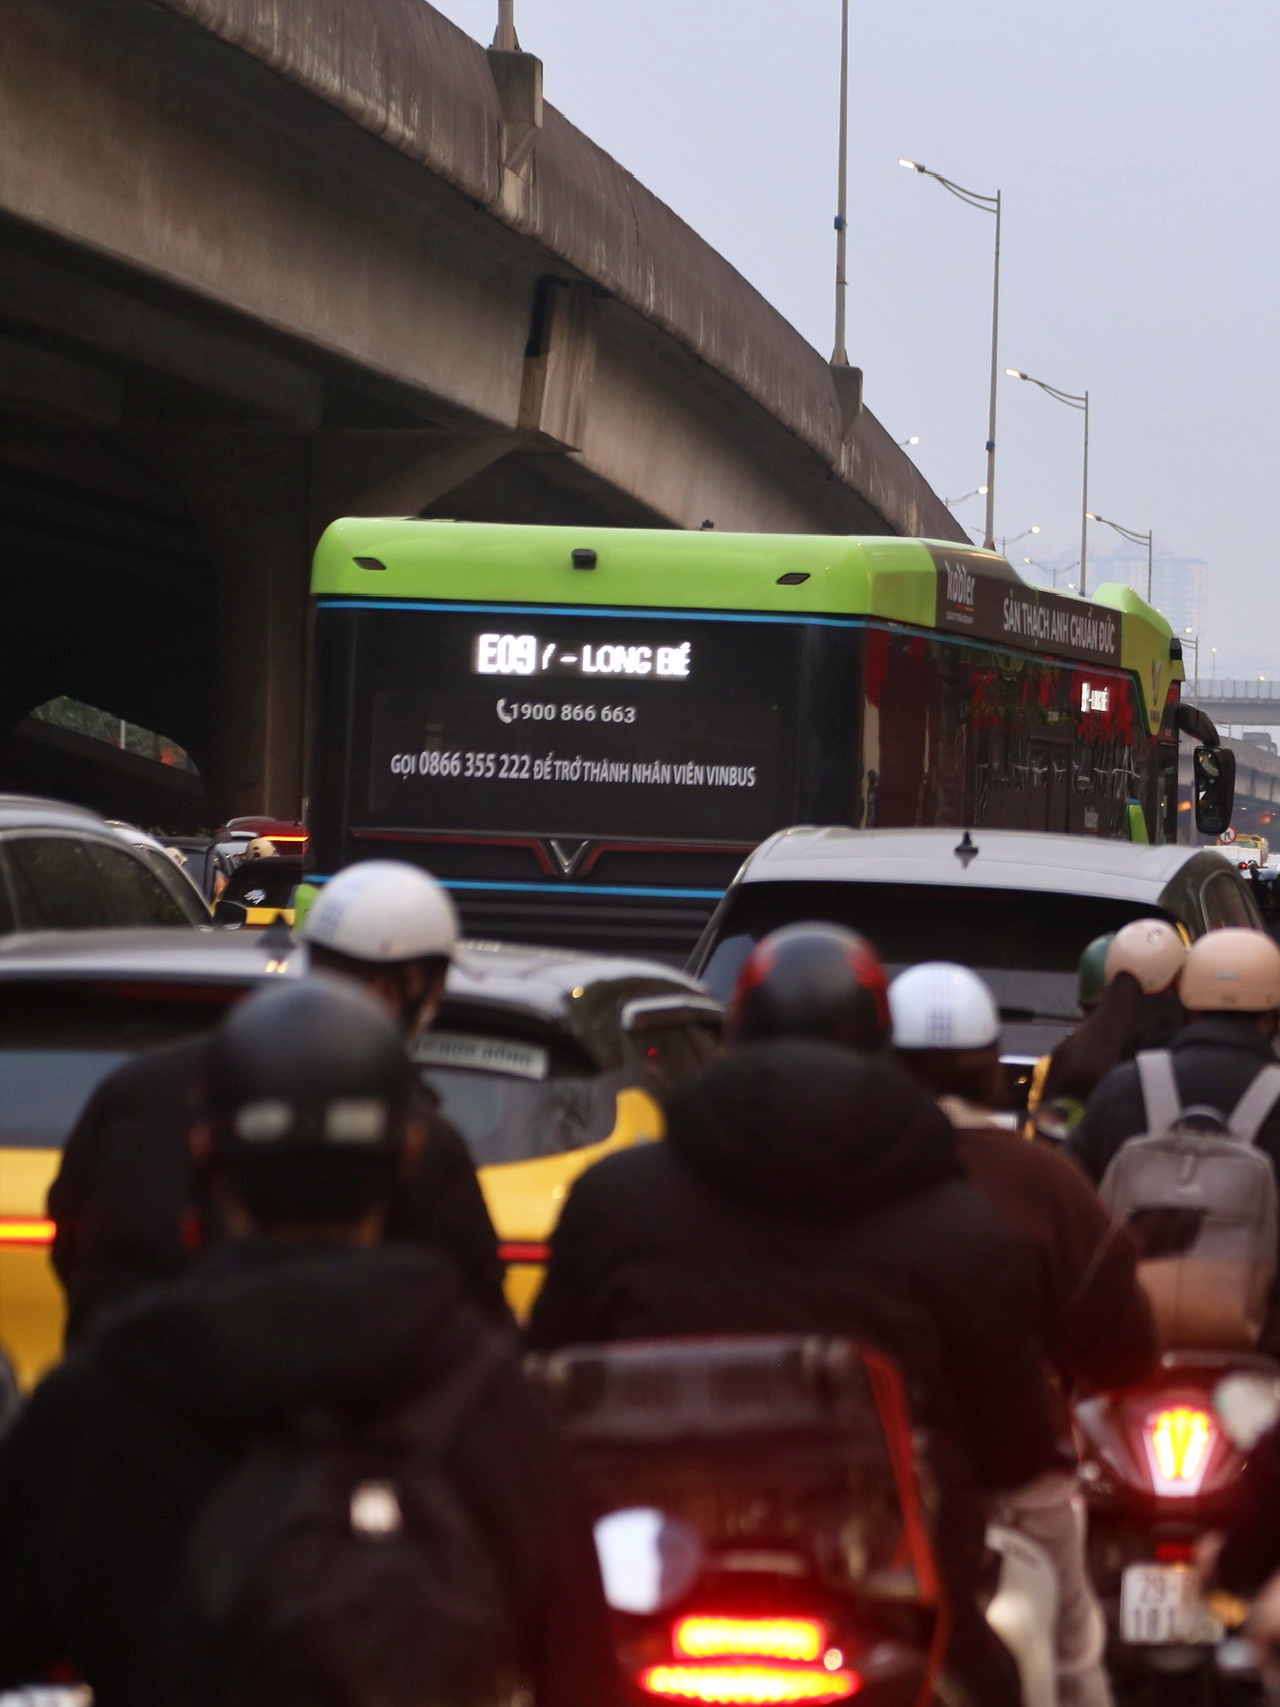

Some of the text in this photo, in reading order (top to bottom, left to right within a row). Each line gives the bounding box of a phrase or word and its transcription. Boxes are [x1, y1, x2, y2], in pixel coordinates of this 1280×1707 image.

[1022, 602, 1050, 646] THẠCH
[1051, 611, 1069, 644] ANH
[1070, 606, 1099, 650] CHUẨN
[1099, 615, 1116, 654] ĐỨC
[477, 633, 537, 674] E09
[582, 644, 652, 674] LONG
[509, 702, 636, 724] 1900 866 663
[390, 750, 756, 787] GỌI 0866 355 222 ĐỂ TRỞ THÀNH NHÂN VIÊN VINBUS
